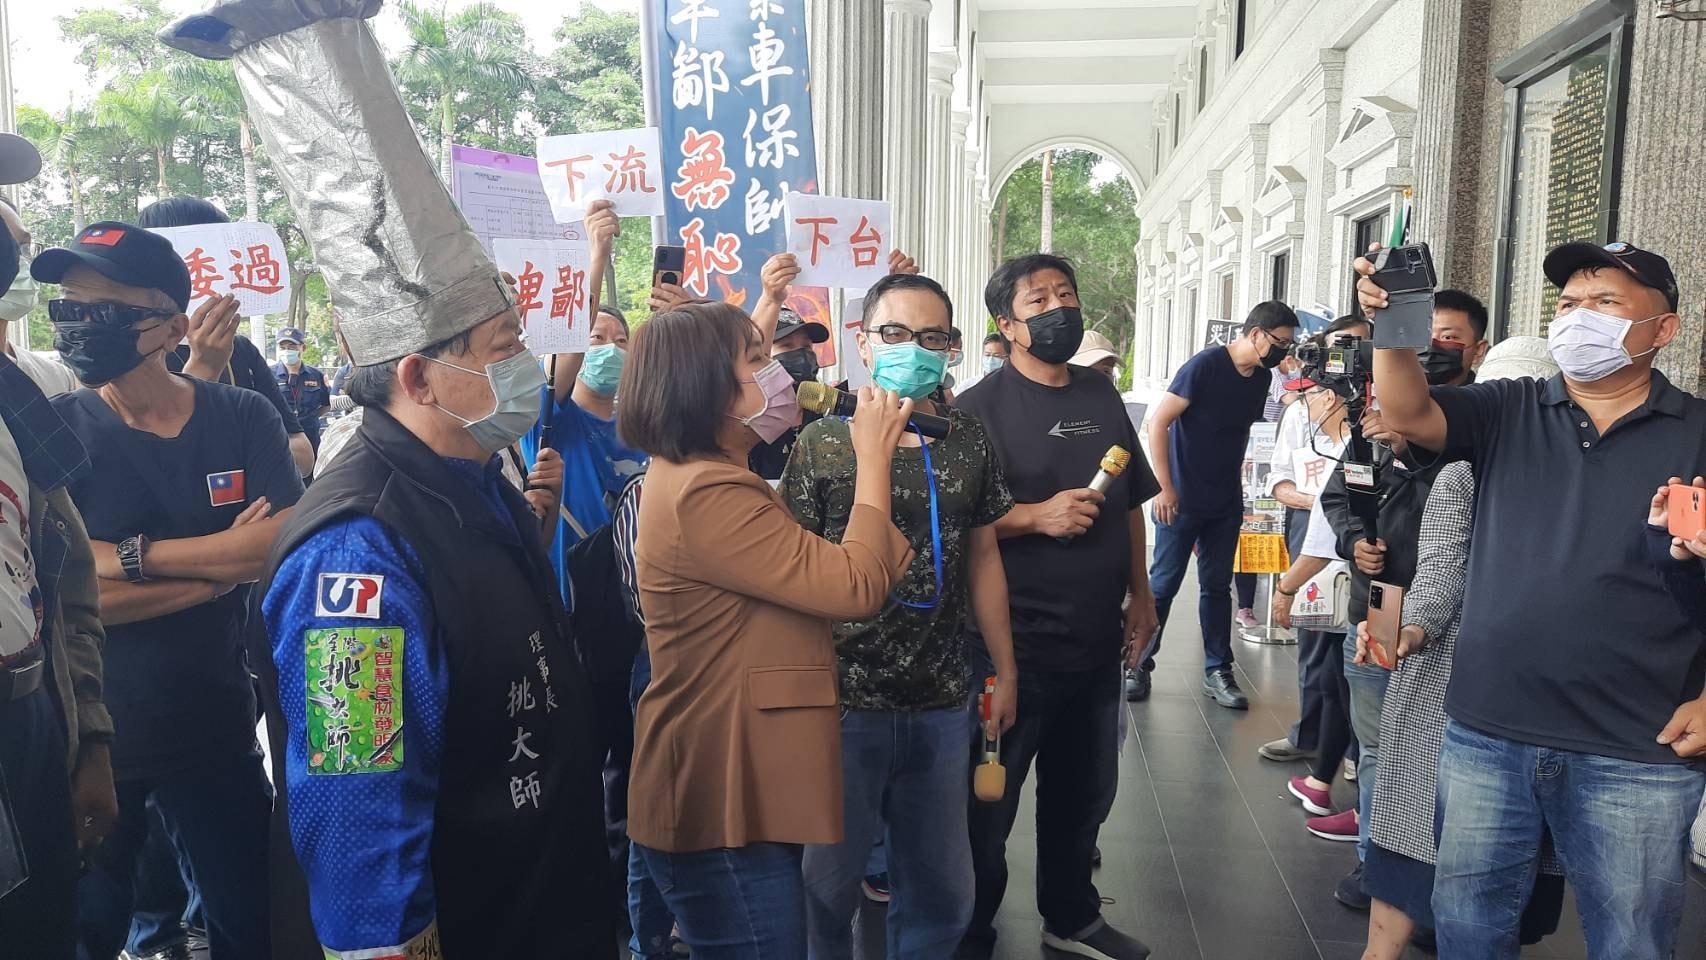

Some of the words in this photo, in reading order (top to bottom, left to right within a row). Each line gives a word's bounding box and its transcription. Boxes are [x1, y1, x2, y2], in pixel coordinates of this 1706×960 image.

[741, 0, 800, 235] 車保帥
[545, 145, 656, 201] 下流
[795, 215, 882, 267] 下台
[1063, 420, 1091, 428] ELEMENT
[1074, 428, 1100, 436] FITNESS
[321, 576, 378, 613] UP
[529, 631, 559, 712] 理事長
[506, 676, 541, 808] 挑大師
